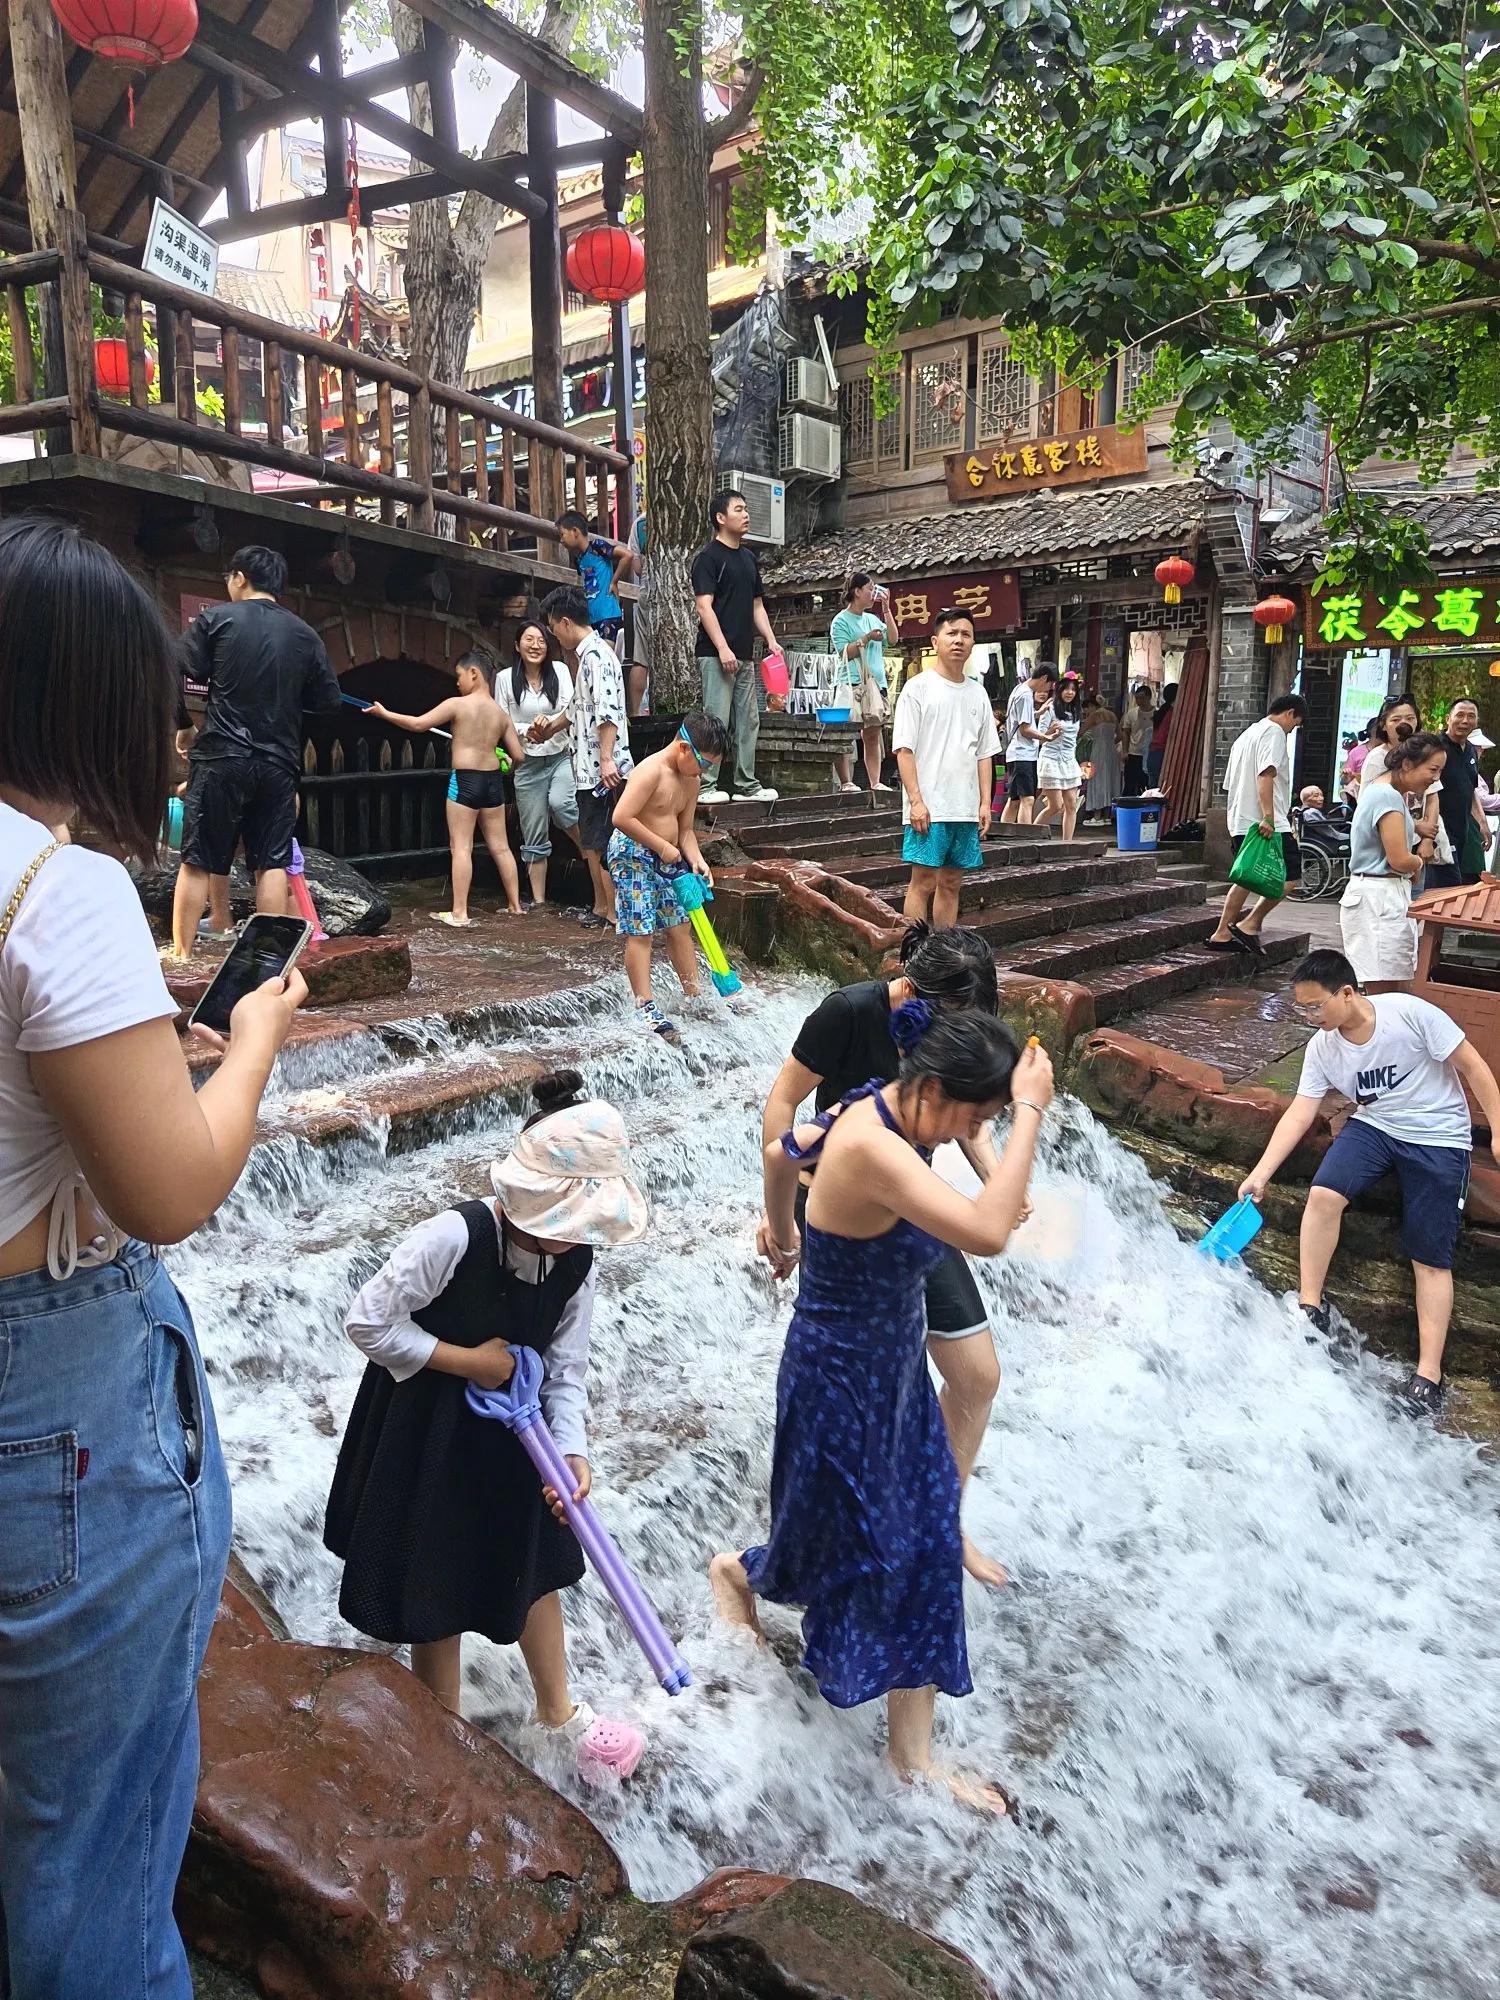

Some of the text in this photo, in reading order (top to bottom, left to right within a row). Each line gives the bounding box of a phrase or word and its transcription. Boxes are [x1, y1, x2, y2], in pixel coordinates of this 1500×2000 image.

[153, 246, 209, 292] 请勿赤脚下水
[159, 220, 212, 272] 沟渠湿滑
[965, 435, 1103, 487] 合你意客栈
[1317, 587, 1500, 643] 茯苓葛
[1357, 1064, 1397, 1090] NIKE
